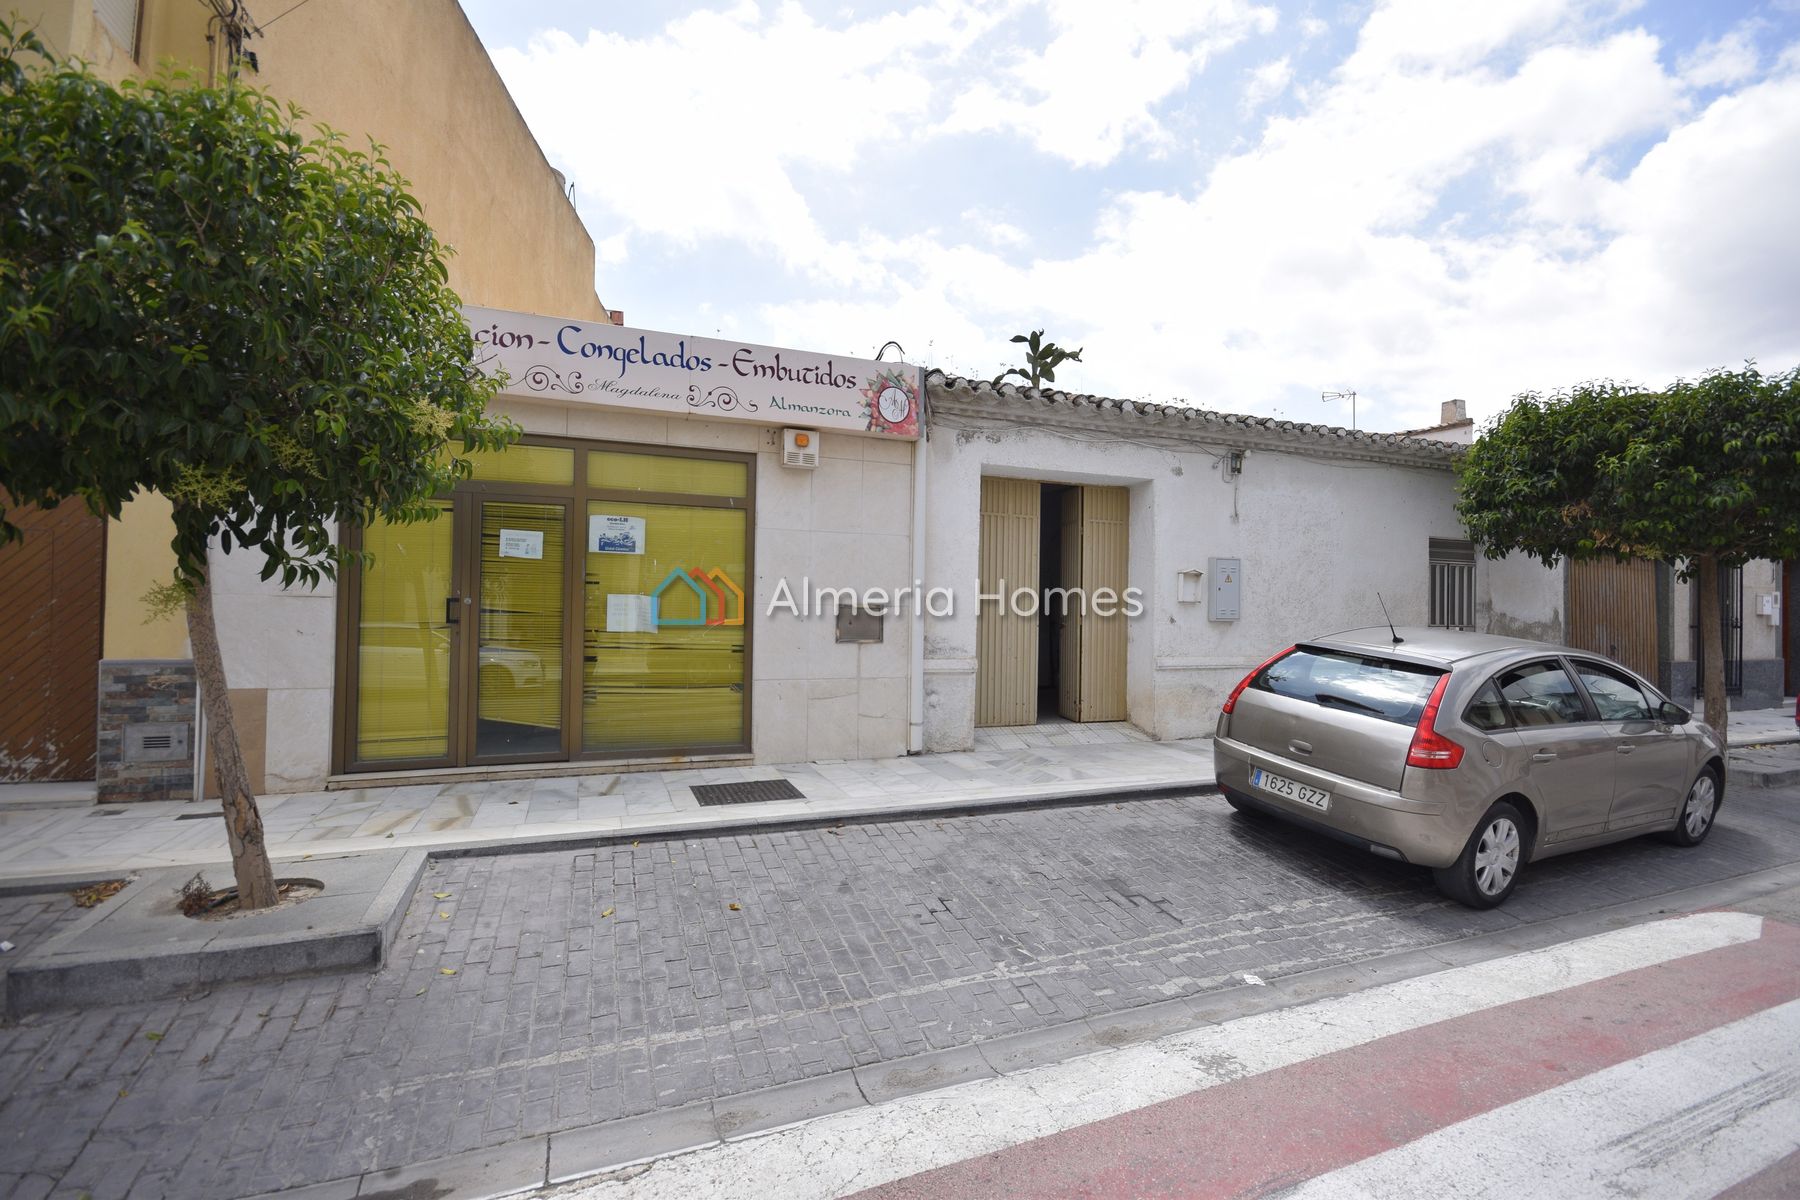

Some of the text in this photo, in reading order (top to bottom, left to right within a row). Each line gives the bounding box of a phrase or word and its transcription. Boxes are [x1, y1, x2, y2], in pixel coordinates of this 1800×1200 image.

[588, 378, 682, 400] Magdalena
[768, 395, 852, 418] Almanzora
[1264, 774, 1327, 808] 1625 GZZ
